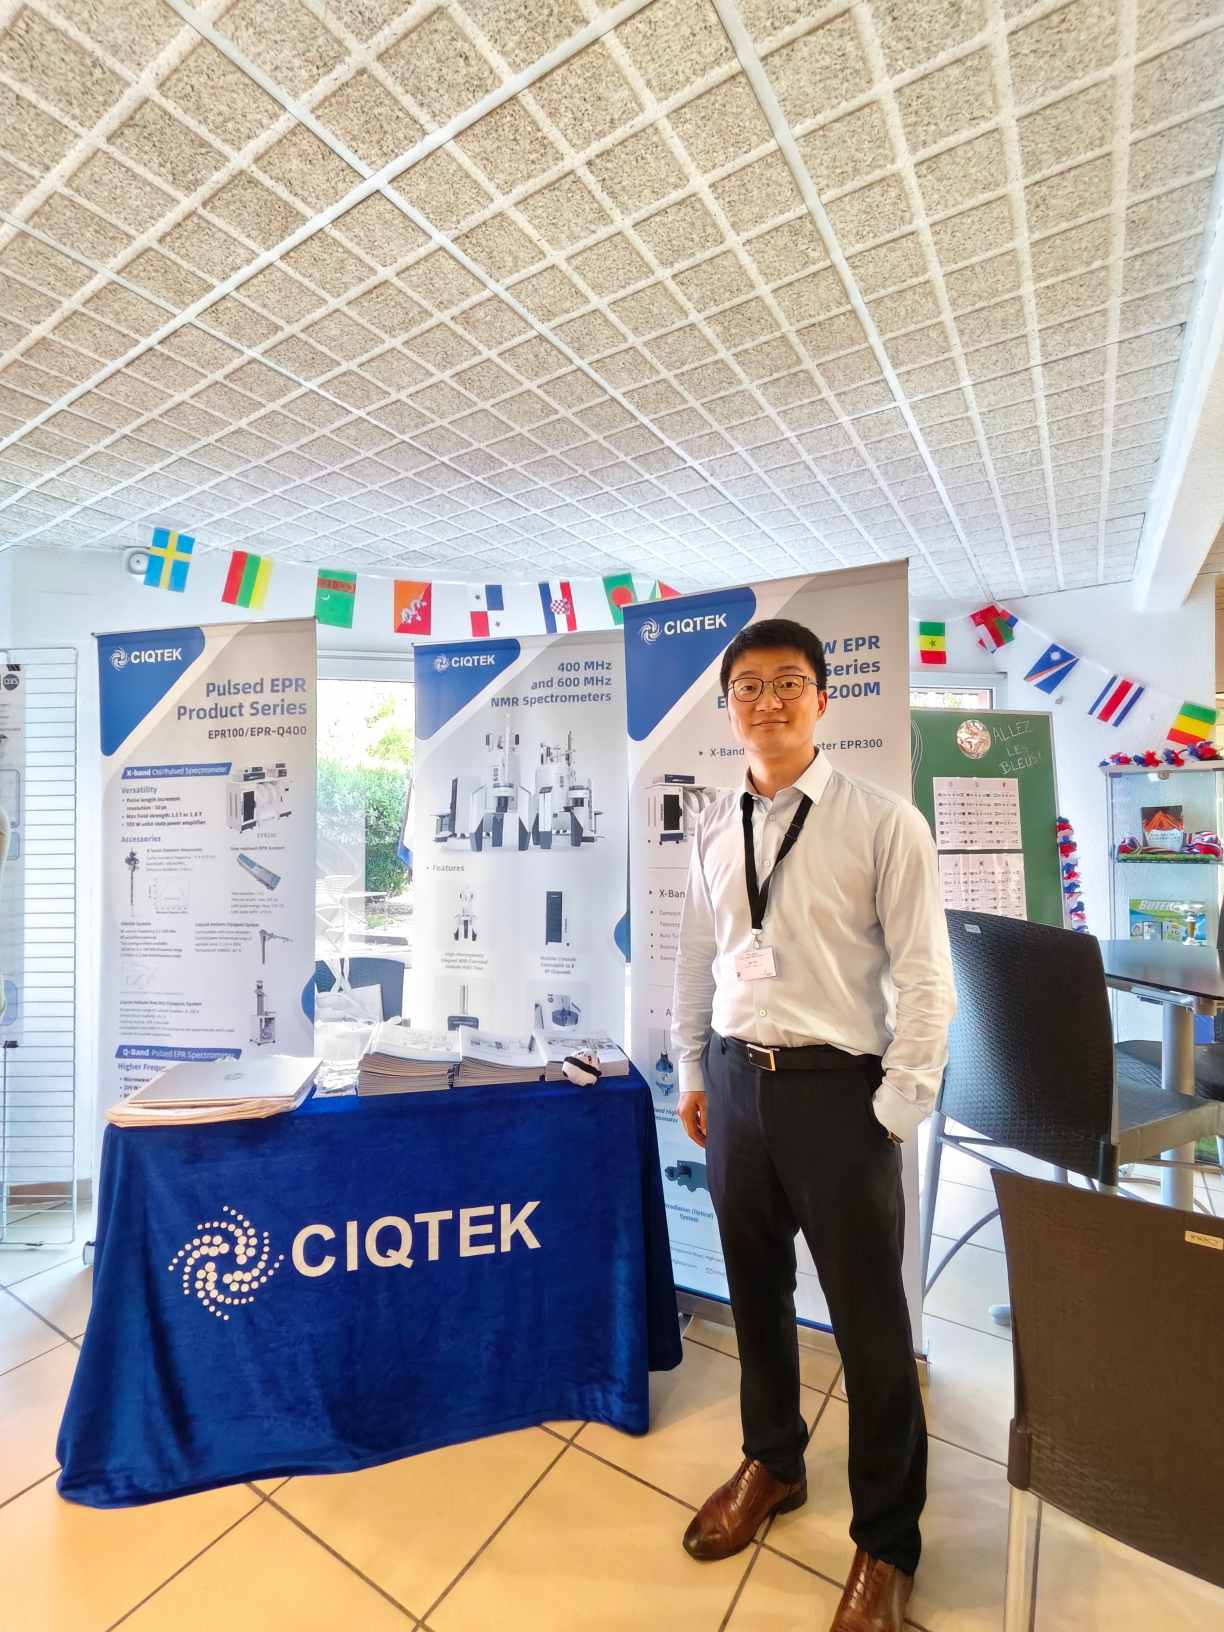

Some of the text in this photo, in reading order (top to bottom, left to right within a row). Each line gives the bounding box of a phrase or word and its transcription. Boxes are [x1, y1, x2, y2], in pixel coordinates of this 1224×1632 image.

[664, 613, 727, 635] CIQTEK
[843, 635, 881, 652] EPR
[130, 648, 182, 664] CIQTEK
[452, 655, 496, 667] CIQTEK
[557, 660, 612, 672] 400 MHz
[825, 659, 881, 677] Series
[206, 677, 306, 697] Pulsed EPR
[531, 676, 612, 690] and 600 MHz
[828, 681, 881, 700] 200M
[491, 692, 612, 708] NMR Spectrometers
[177, 699, 307, 721] Product Series
[208, 726, 307, 740] EPR100/EPR-Q400
[710, 747, 745, 757] X-Band
[840, 738, 883, 750] EPR300
[432, 864, 464, 872] Features
[659, 889, 685, 898] X-Ban
[292, 1201, 542, 1278] CIQTEK
